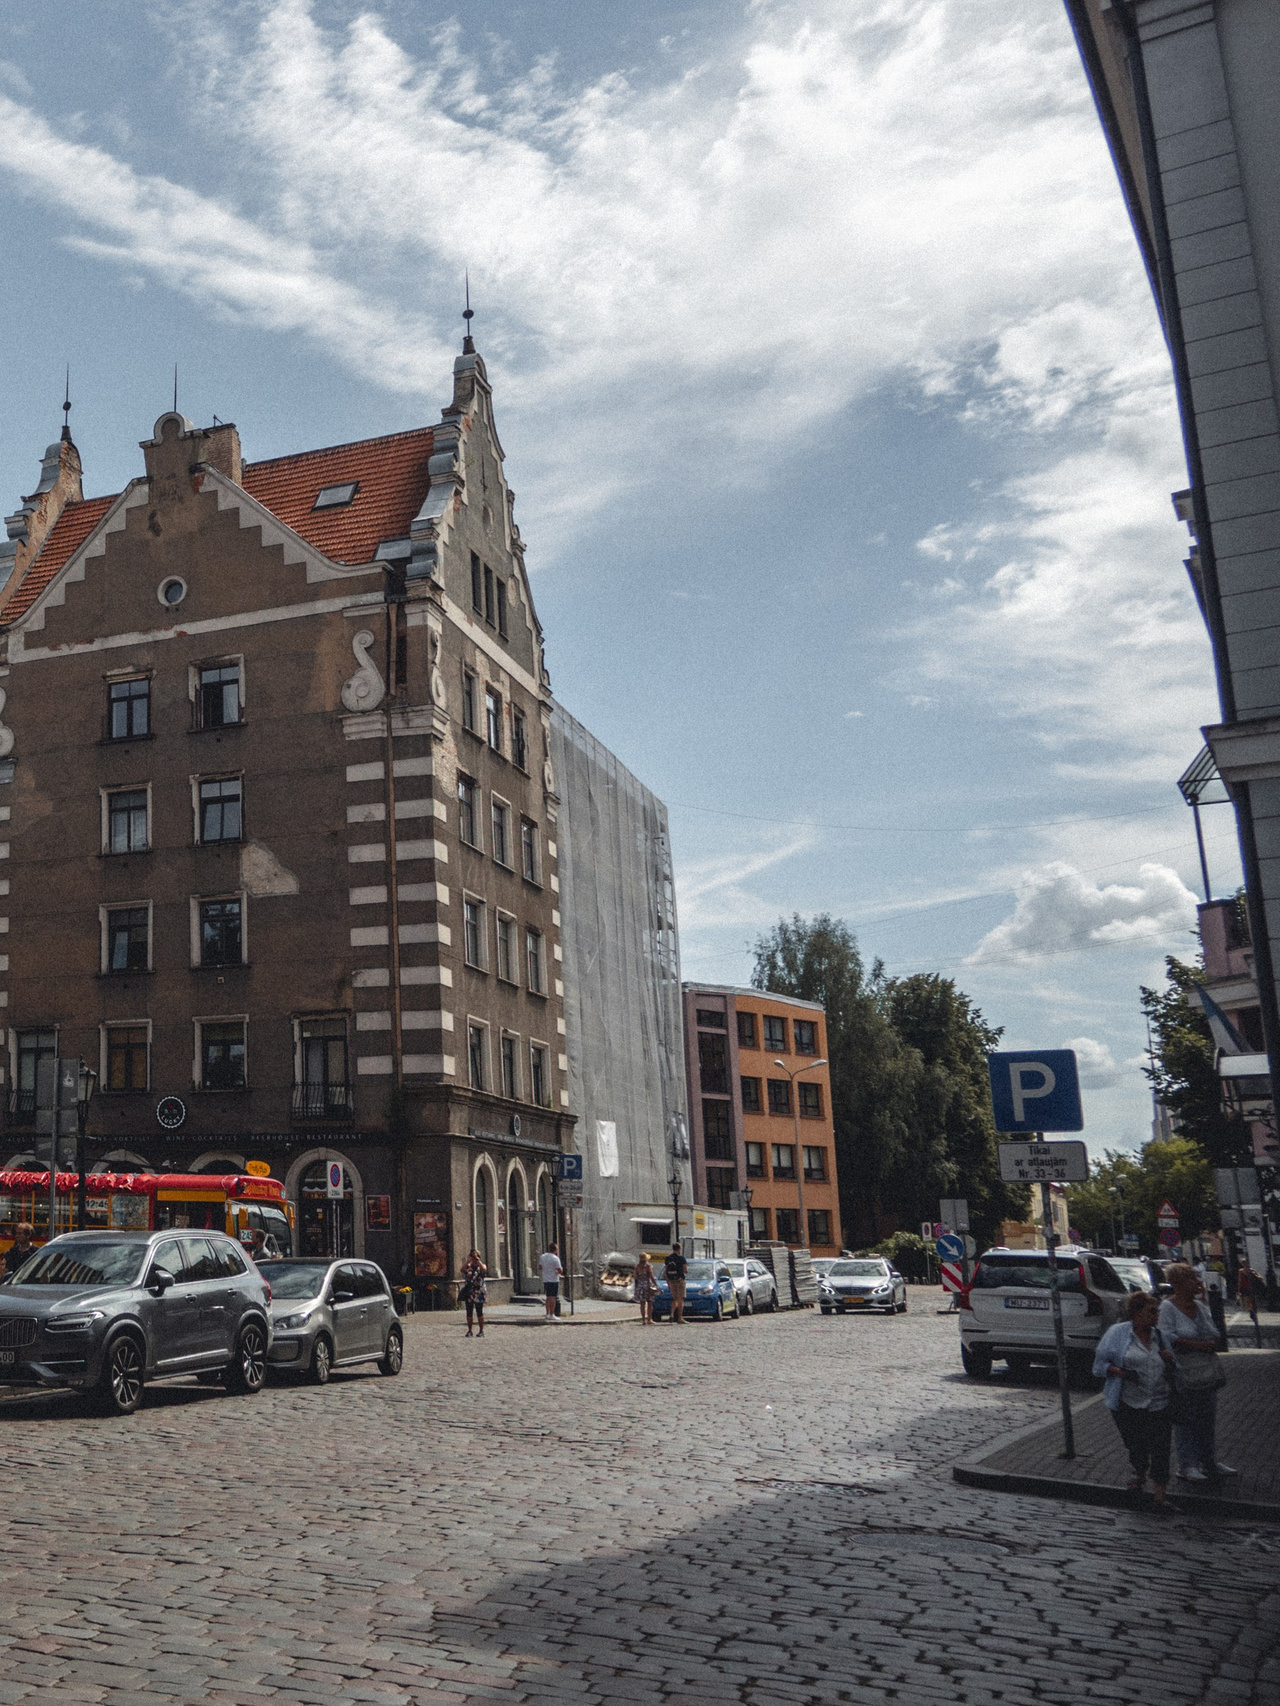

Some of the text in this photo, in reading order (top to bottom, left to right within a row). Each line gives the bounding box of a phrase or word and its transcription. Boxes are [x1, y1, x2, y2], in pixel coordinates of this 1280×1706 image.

[1008, 1061, 1056, 1122] P
[1028, 1145, 1051, 1155] Tikai
[563, 1157, 577, 1176] P
[1014, 1159, 1024, 1167] ar
